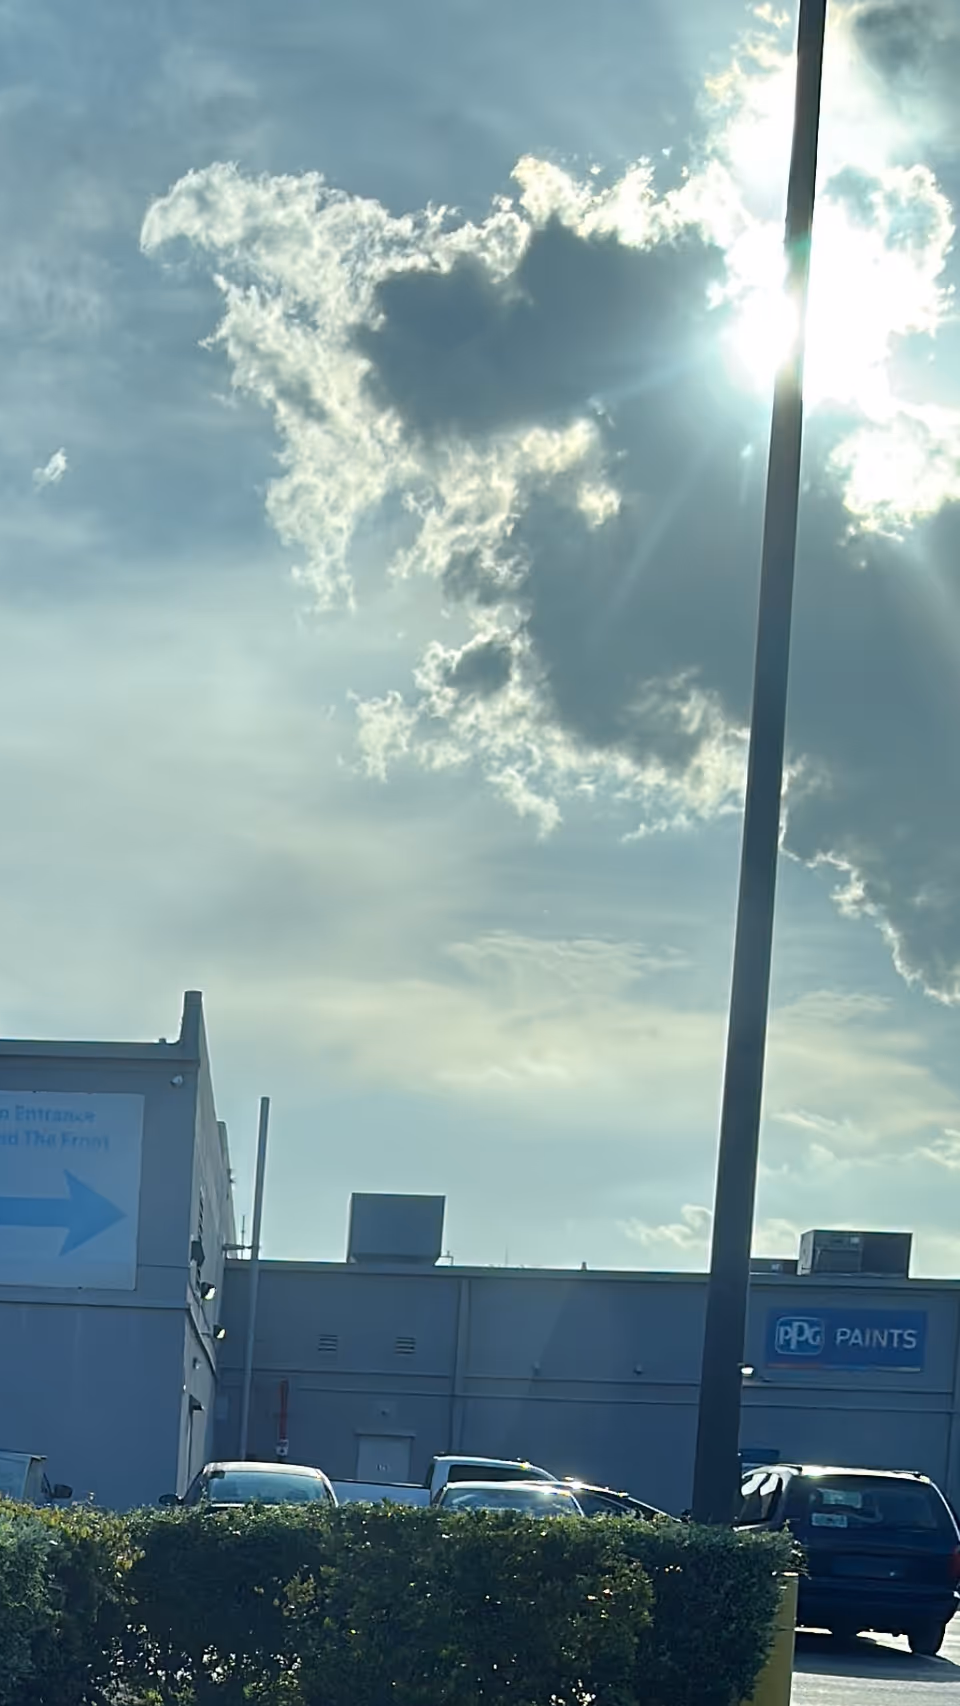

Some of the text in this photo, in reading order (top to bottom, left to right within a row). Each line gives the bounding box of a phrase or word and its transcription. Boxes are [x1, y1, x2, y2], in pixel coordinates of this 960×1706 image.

[15, 1104, 96, 1123] Entrance
[25, 1130, 56, 1147] The
[60, 1132, 110, 1150] Front
[778, 1321, 918, 1350] PPG PAINTS
